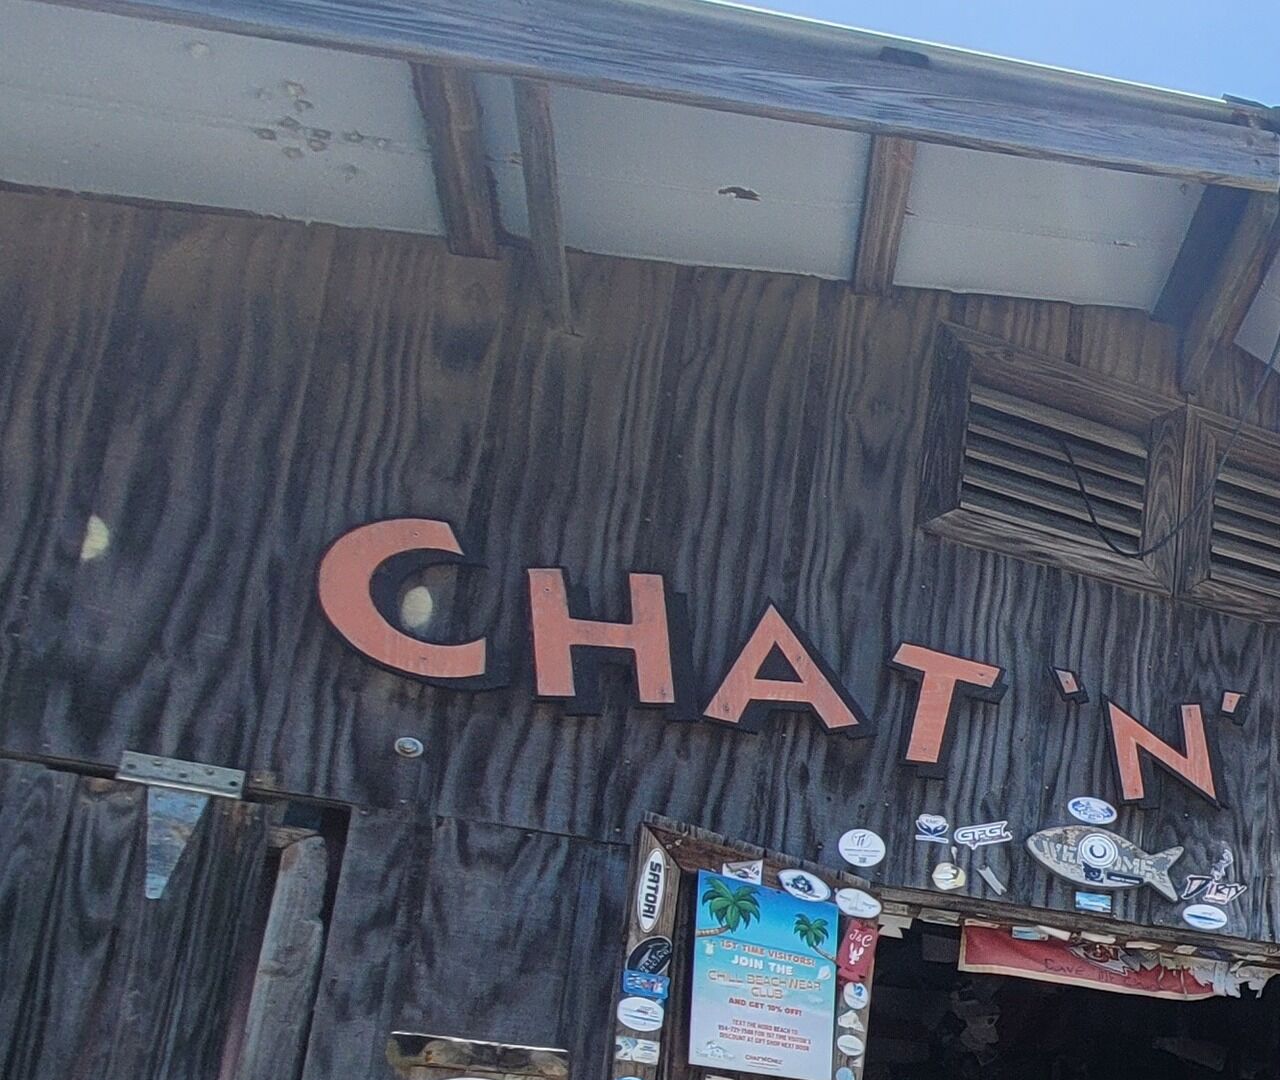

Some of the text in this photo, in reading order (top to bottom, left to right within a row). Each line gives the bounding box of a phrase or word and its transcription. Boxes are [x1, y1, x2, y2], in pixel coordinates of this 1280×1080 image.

[318, 518, 1001, 763] CHAT
[642, 861, 662, 919] SATORI
[849, 928, 873, 947] J&C
[742, 944, 765, 956] TIME
[731, 954, 795, 976] JOIN THE
[751, 986, 784, 999] CLUB
[728, 997, 746, 1006] AND
[748, 1000, 765, 1009] GET
